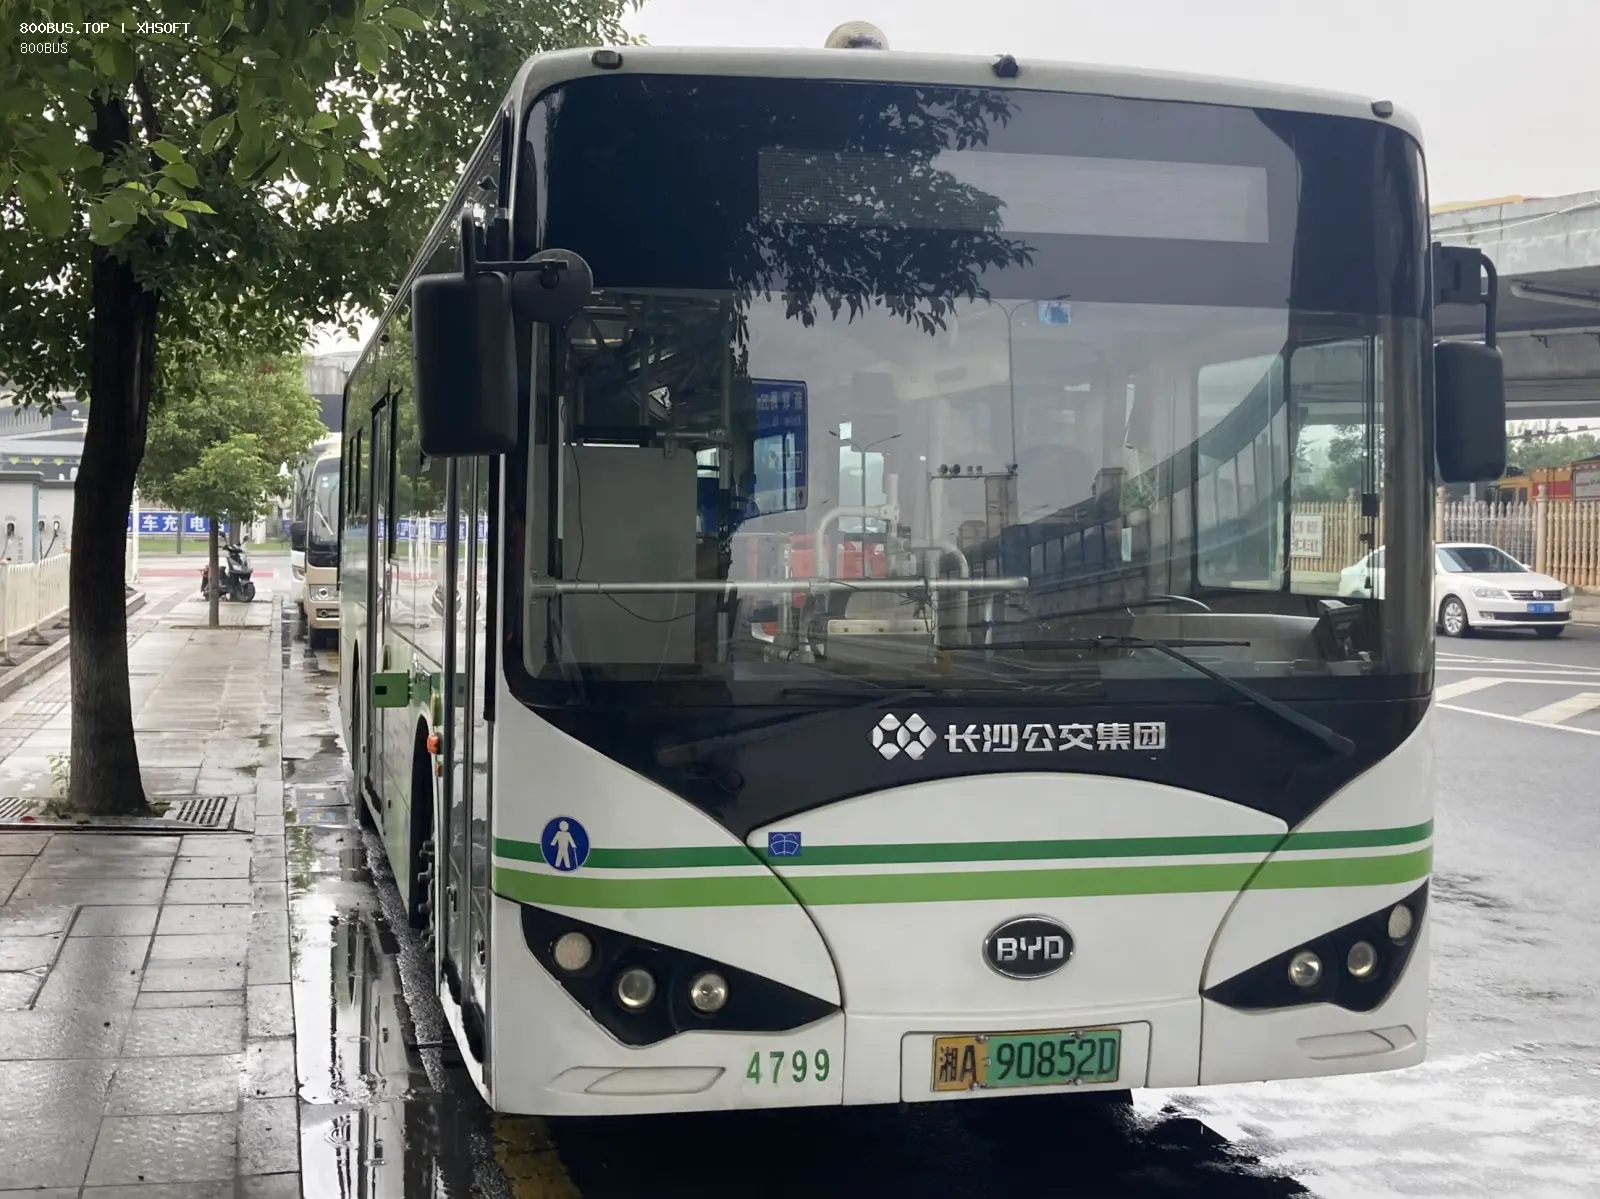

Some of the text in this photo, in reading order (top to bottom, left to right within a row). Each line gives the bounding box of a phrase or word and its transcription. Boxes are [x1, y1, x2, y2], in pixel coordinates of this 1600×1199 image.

[944, 721, 1167, 753] 长沙公交集团
[997, 934, 1065, 962] BYD
[746, 1048, 831, 1084] 4799
